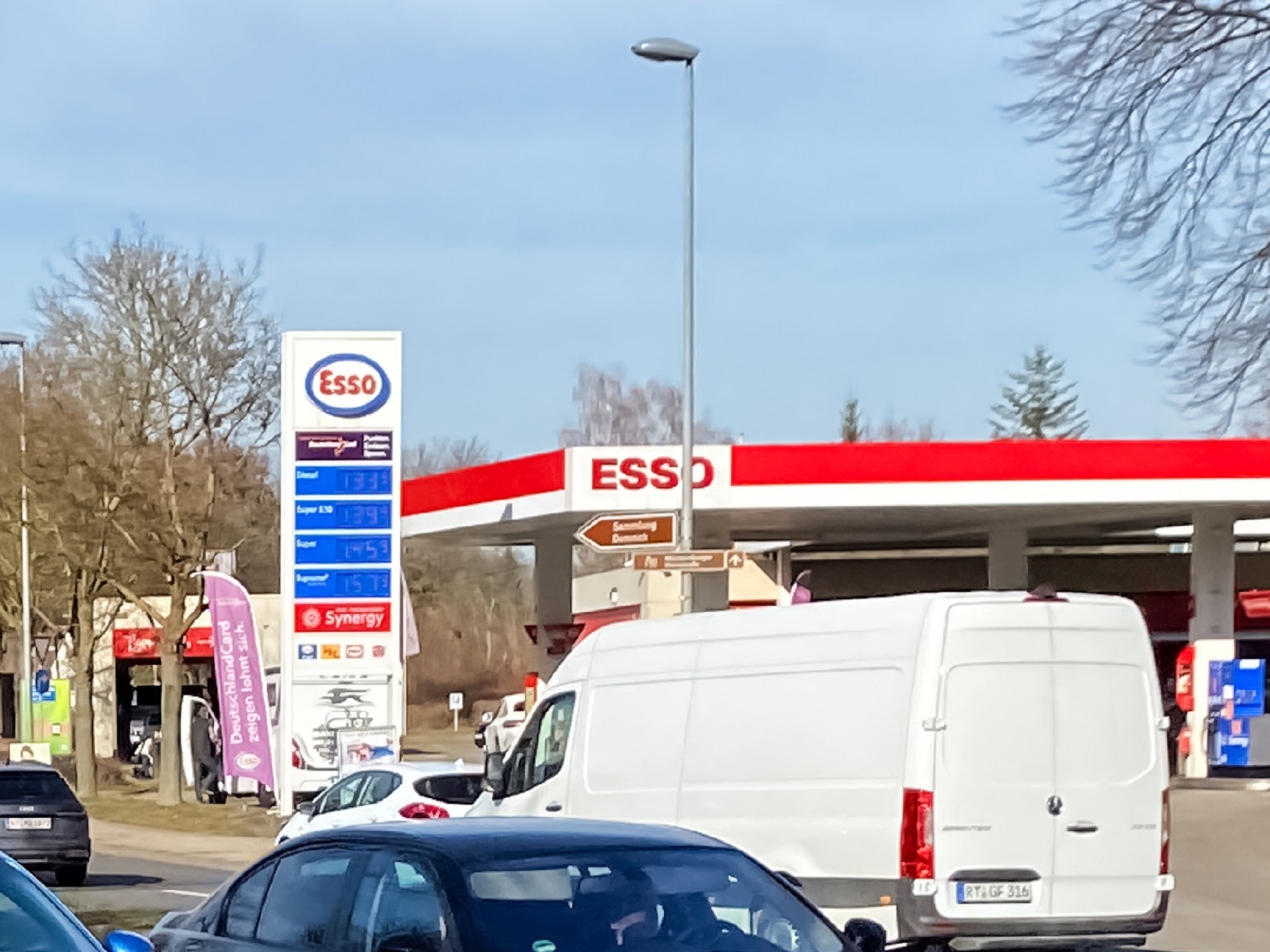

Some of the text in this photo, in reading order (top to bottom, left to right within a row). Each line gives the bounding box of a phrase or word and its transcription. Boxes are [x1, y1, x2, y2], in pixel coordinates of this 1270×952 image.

[319, 369, 377, 395] Esso
[592, 456, 715, 490] ESSO
[325, 610, 385, 628] Synergy
[217, 620, 243, 745] DeutschlandCard
[239, 656, 254, 693] lohnt
[245, 694, 261, 743] zeigen
[966, 884, 1030, 898] RT GF 316
